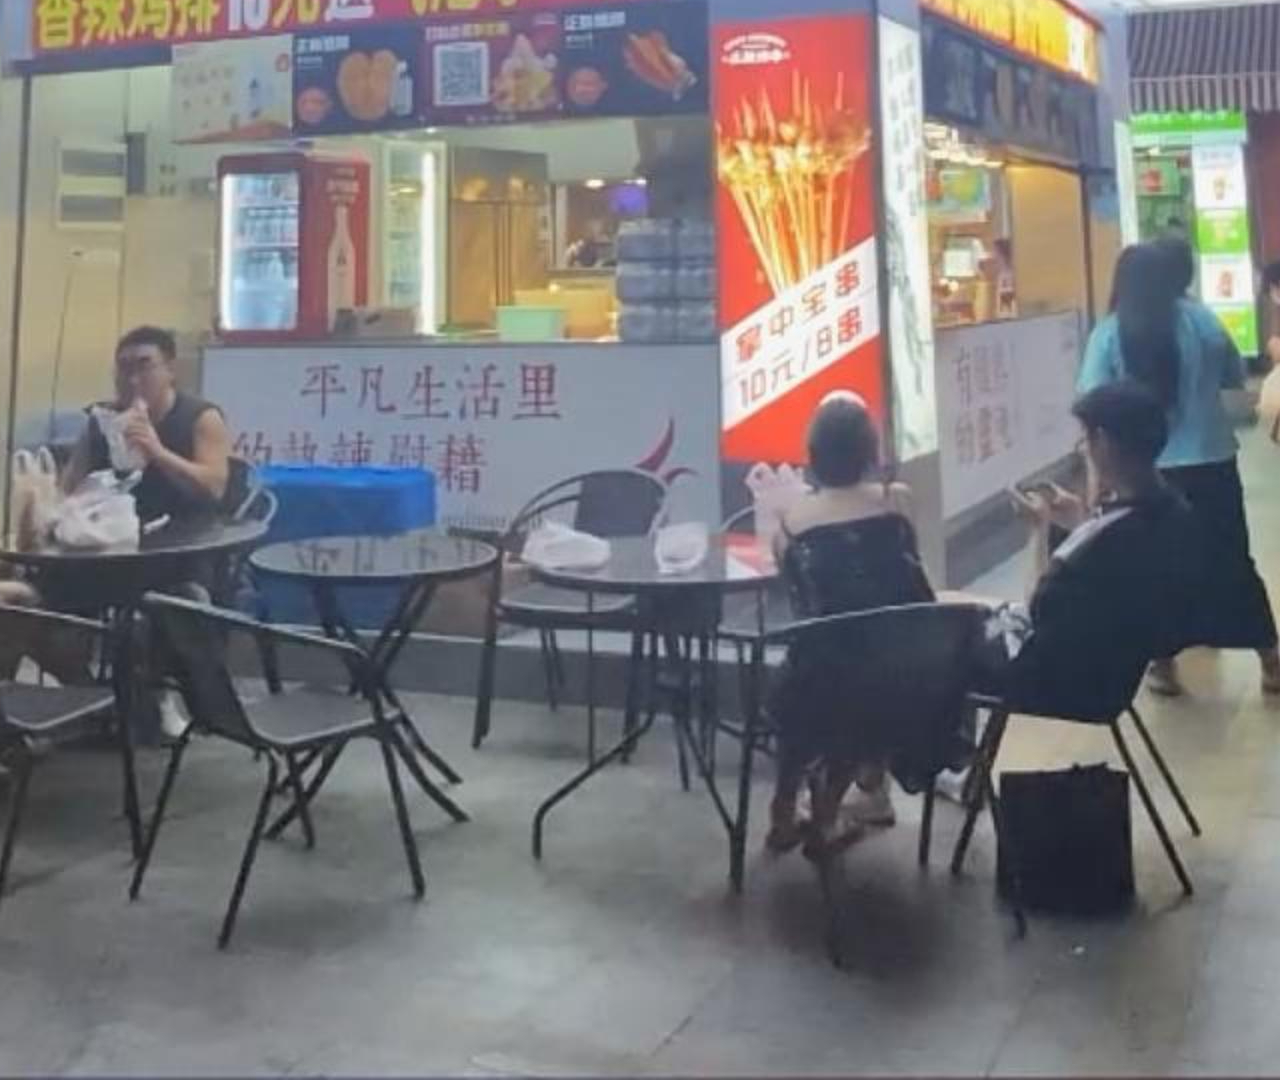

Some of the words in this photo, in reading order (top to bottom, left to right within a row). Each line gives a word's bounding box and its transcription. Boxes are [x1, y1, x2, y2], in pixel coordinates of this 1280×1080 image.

[300, 363, 562, 420] 平凡生活里
